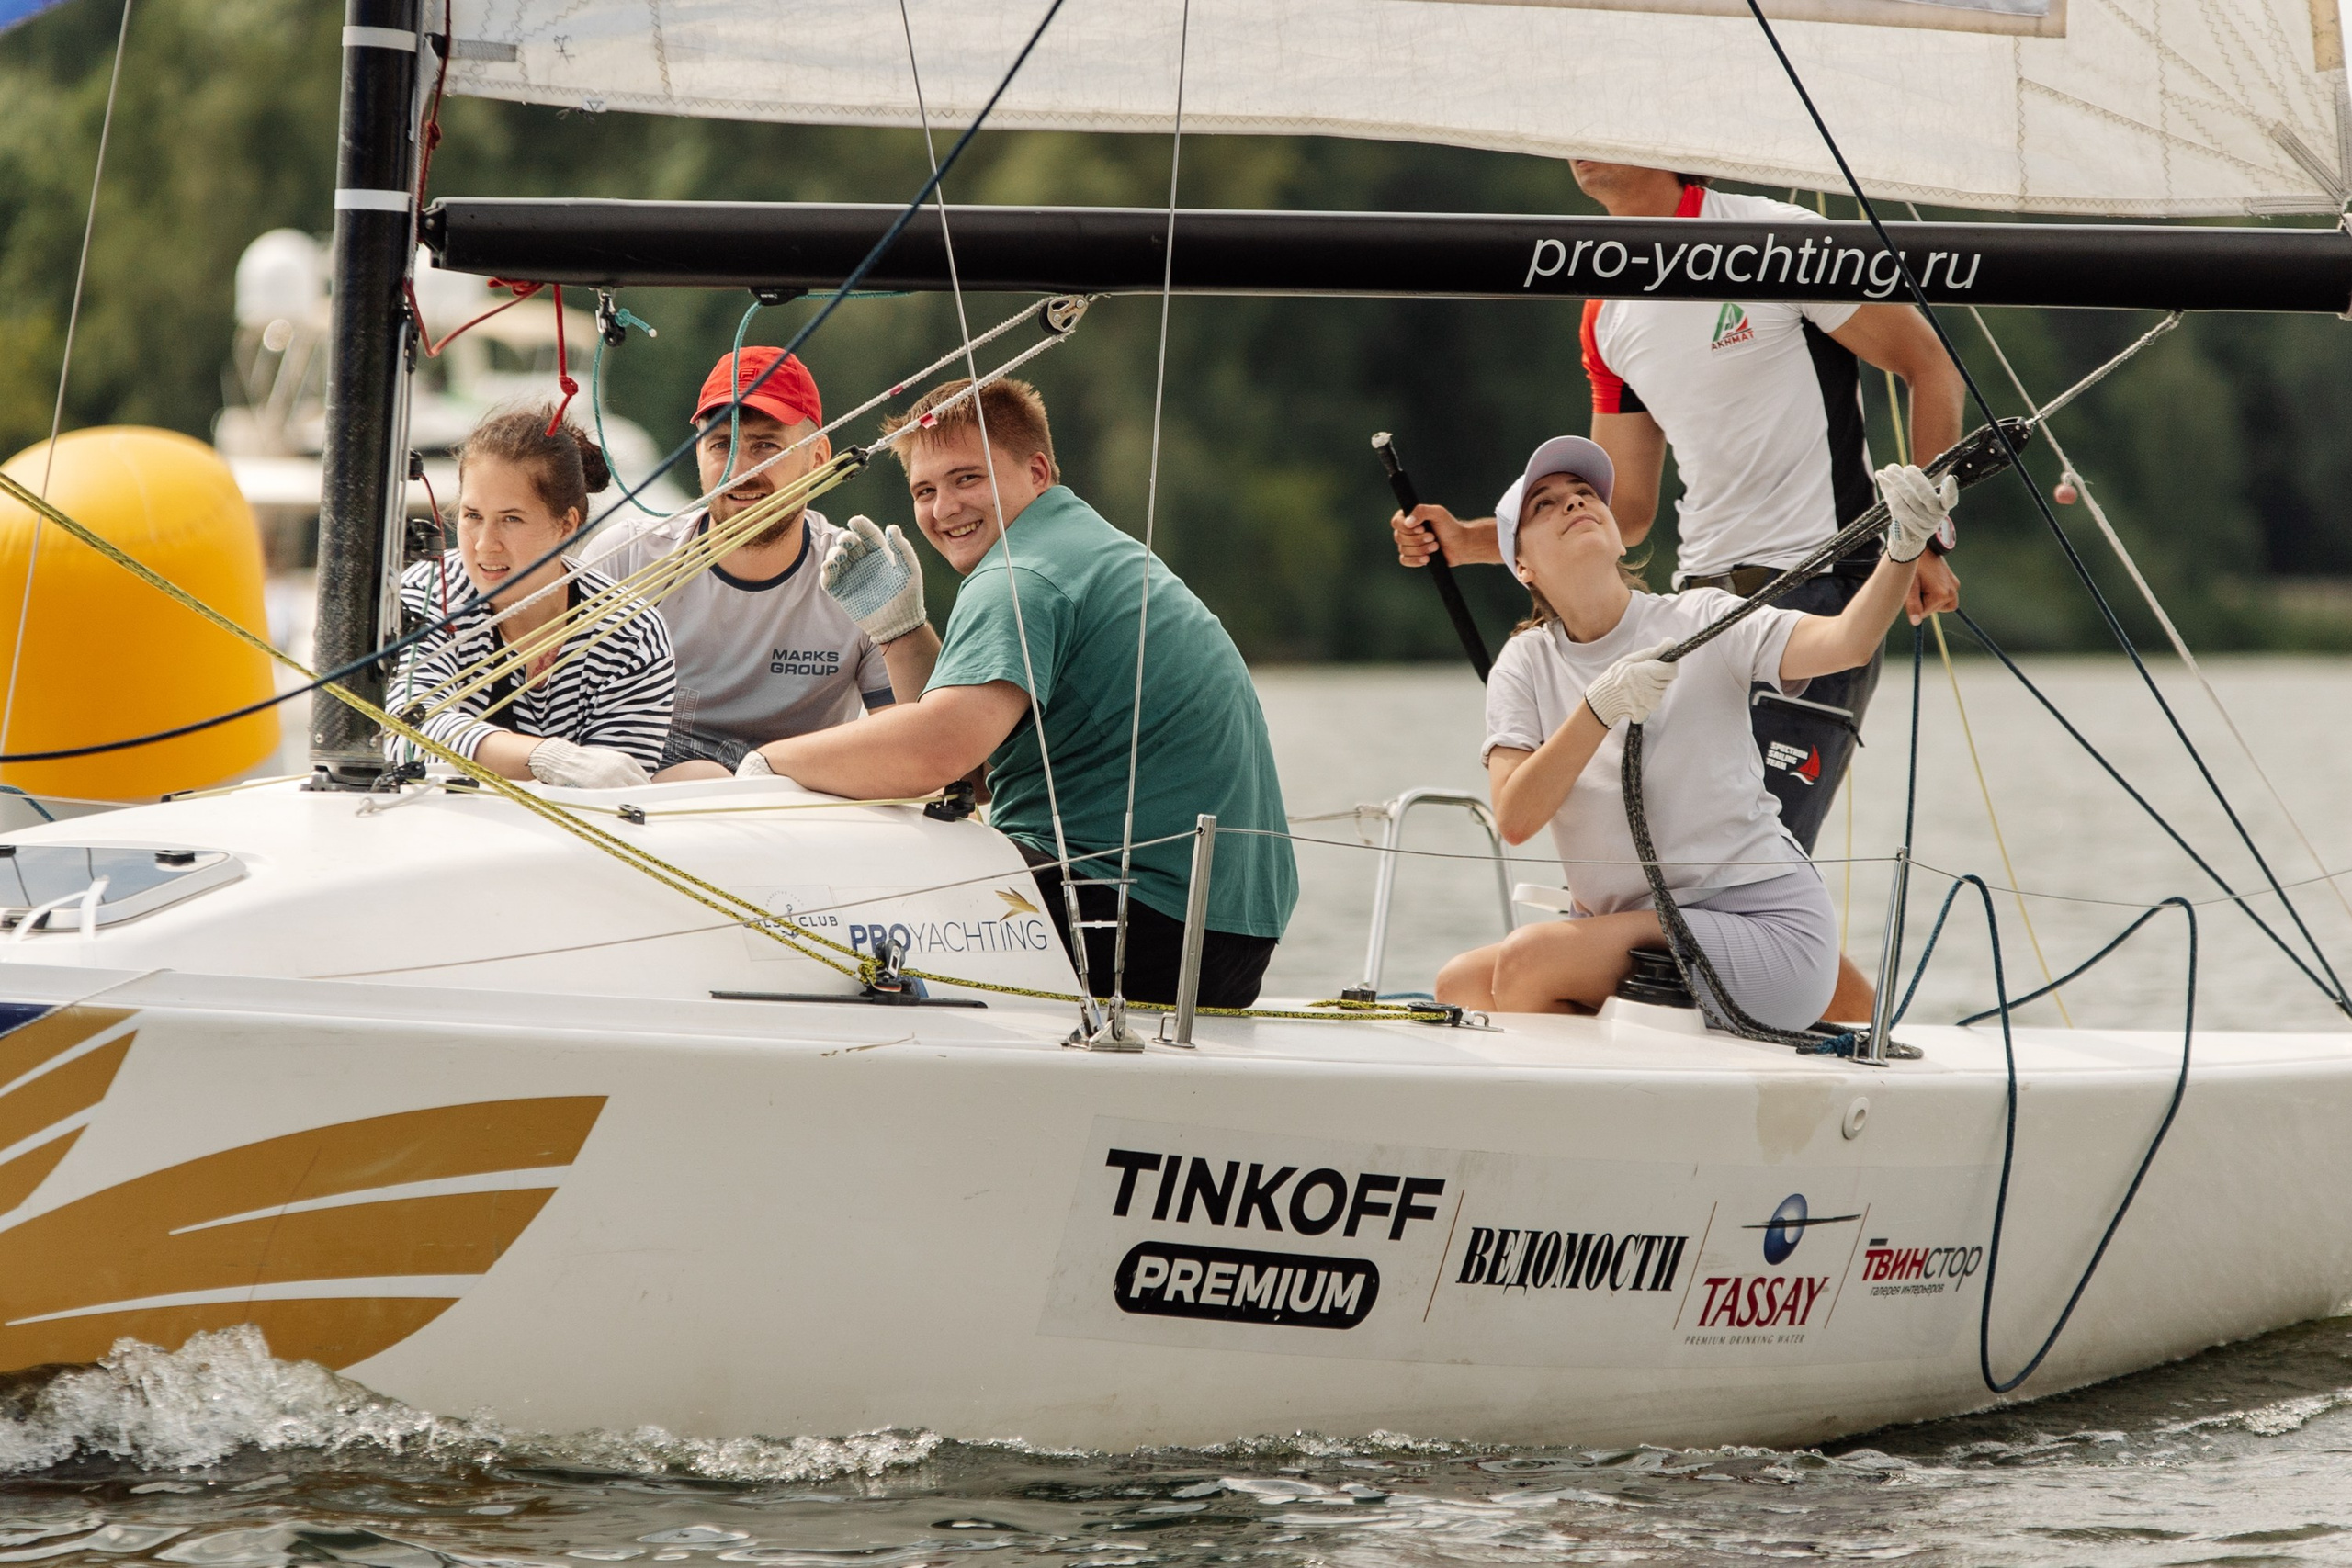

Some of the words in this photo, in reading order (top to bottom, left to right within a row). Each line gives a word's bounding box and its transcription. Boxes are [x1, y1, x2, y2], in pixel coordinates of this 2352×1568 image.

[1523, 233, 1982, 298] pro-yachting.ru
[1711, 330, 1755, 351] AKHMAT
[772, 649, 840, 662] MARKS
[770, 662, 840, 676] GROUP
[798, 915, 840, 928] CLUB
[1105, 1148, 1446, 1241] TINKOFF
[1455, 1226, 1690, 1296] ВЕДОМОСТИ
[1129, 1255, 1366, 1316] PREMIUM
[1870, 1286, 1901, 1299] галерея
[1901, 1284, 1945, 1298] интерьеров
[1697, 1276, 1831, 1328] TASSAY
[1684, 1336, 1726, 1345] PREMIUM
[1728, 1335, 1775, 1345] DRINKING
[1777, 1334, 1806, 1344] WATER
